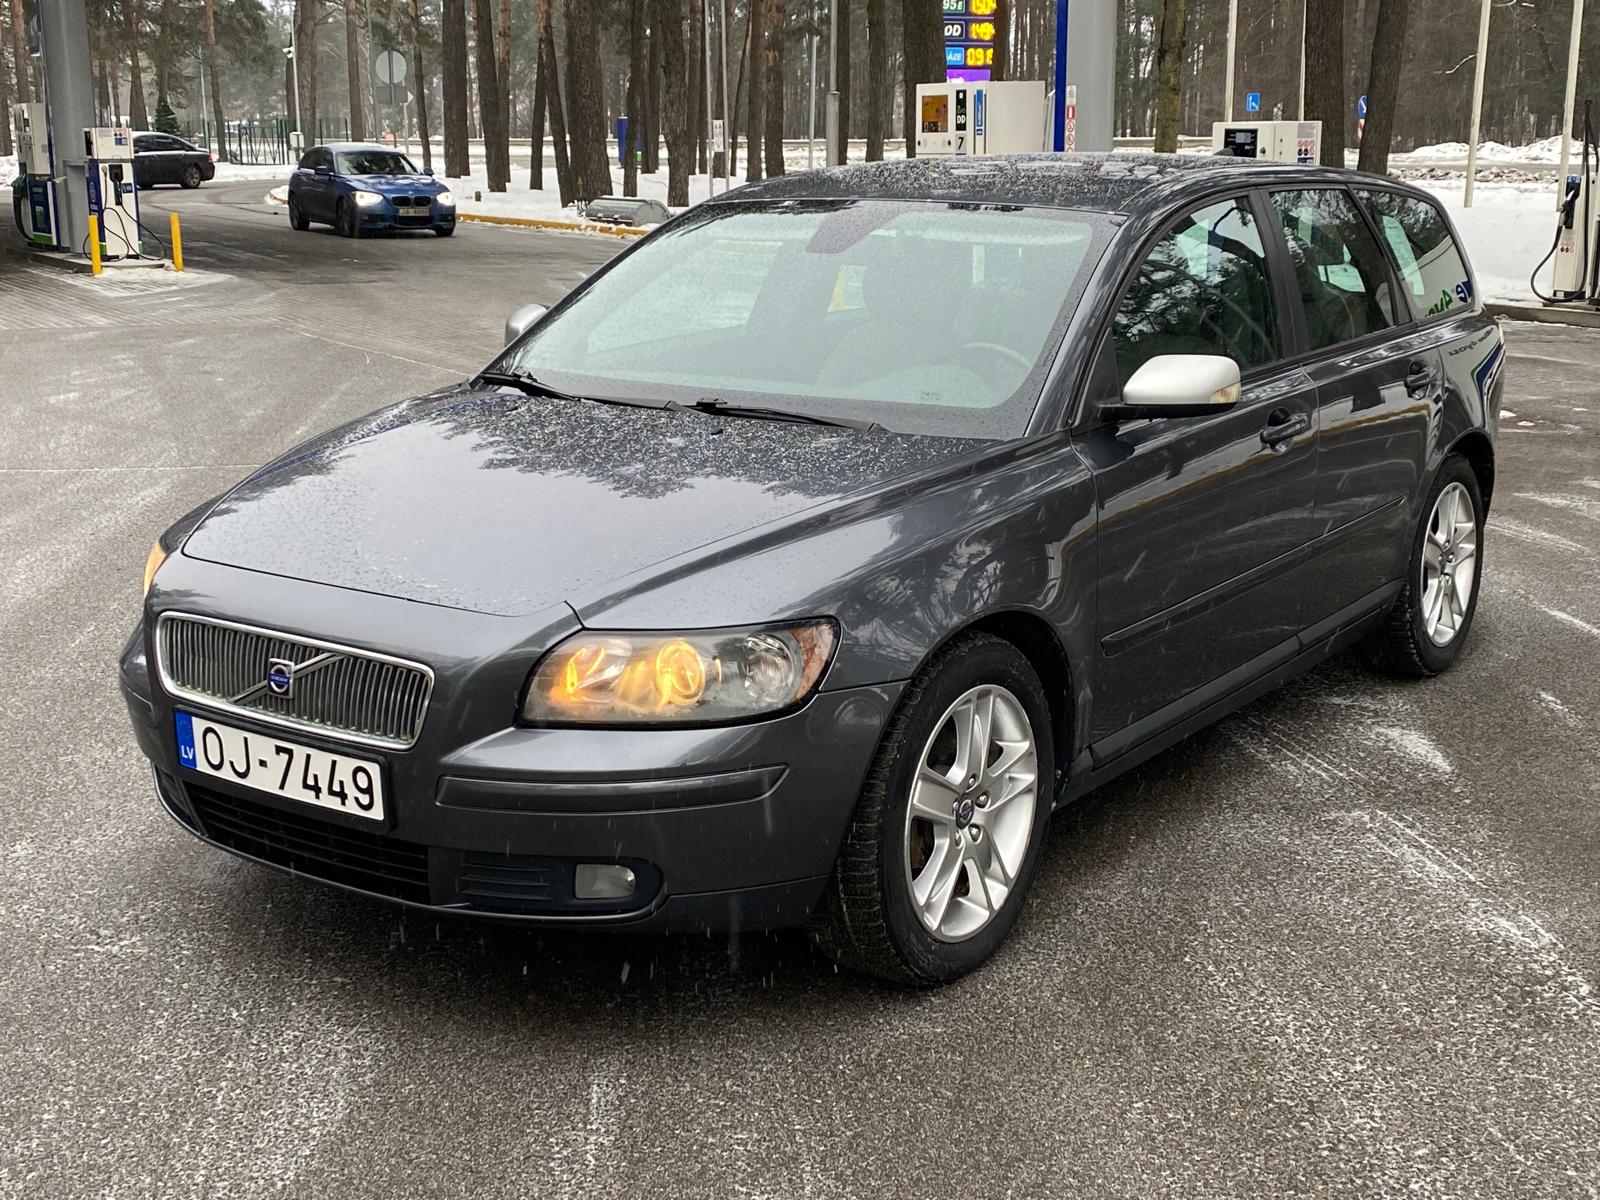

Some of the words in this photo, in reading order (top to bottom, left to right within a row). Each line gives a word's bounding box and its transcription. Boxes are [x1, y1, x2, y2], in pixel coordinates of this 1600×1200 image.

[958, 136, 965, 150] 7
[181, 744, 194, 760] LV
[202, 726, 375, 811] OJ-7449
